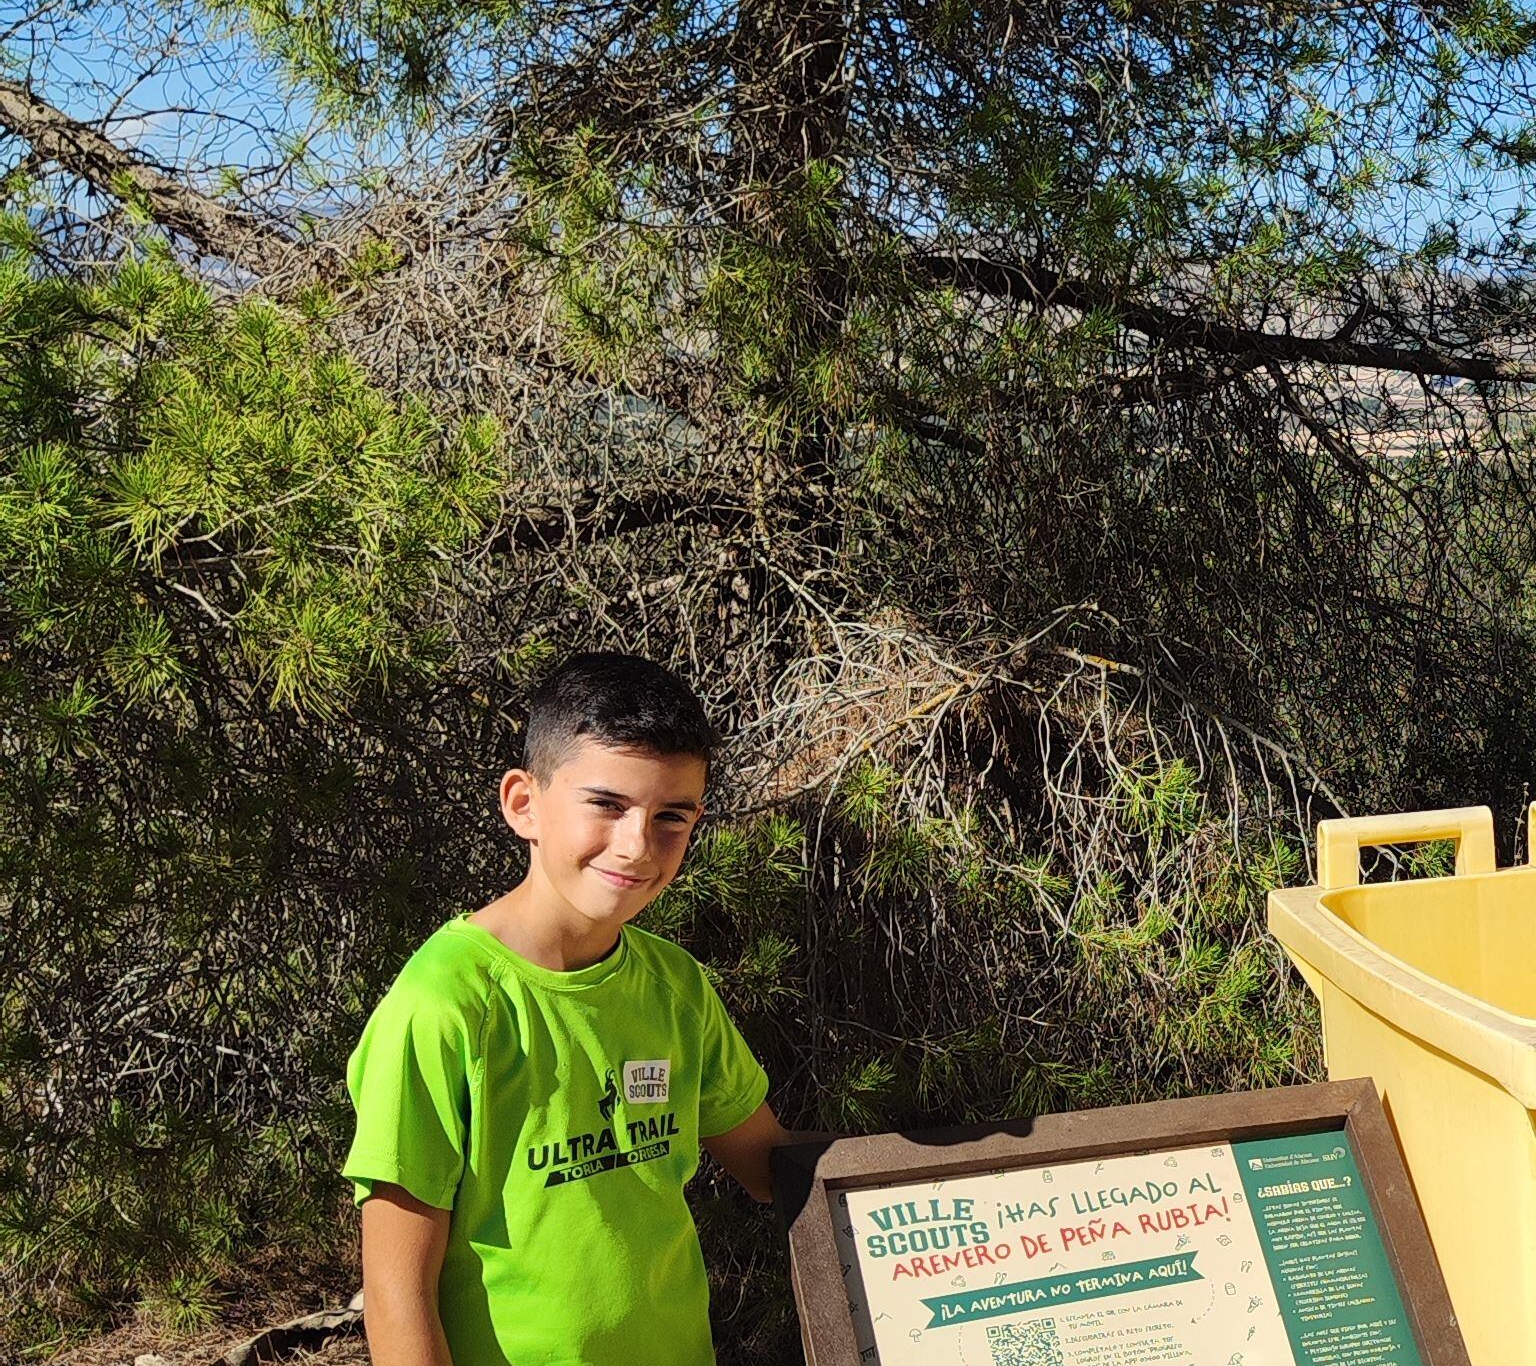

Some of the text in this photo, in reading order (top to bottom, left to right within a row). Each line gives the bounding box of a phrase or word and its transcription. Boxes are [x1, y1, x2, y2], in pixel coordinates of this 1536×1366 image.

[629, 1082, 667, 1099] SCOUTS
[630, 1066, 666, 1084] VILLE
[527, 1112, 680, 1171] ULTRA TRAIL
[560, 1143, 668, 1182] TORLA ORDESA
[867, 1198, 975, 1232] VILLE
[996, 1172, 1222, 1229] ¡HAS LLEGADO AL
[866, 1221, 990, 1258] SCOUTS
[893, 1243, 1011, 1281] ARENERO
[1020, 1234, 1052, 1259] DE
[1060, 1218, 1132, 1252] PEÑA
[1138, 1196, 1231, 1234] RUBIA!
[941, 1260, 1187, 1321] ¡LA AVENTURA NO TERMINA AQUÍ!
